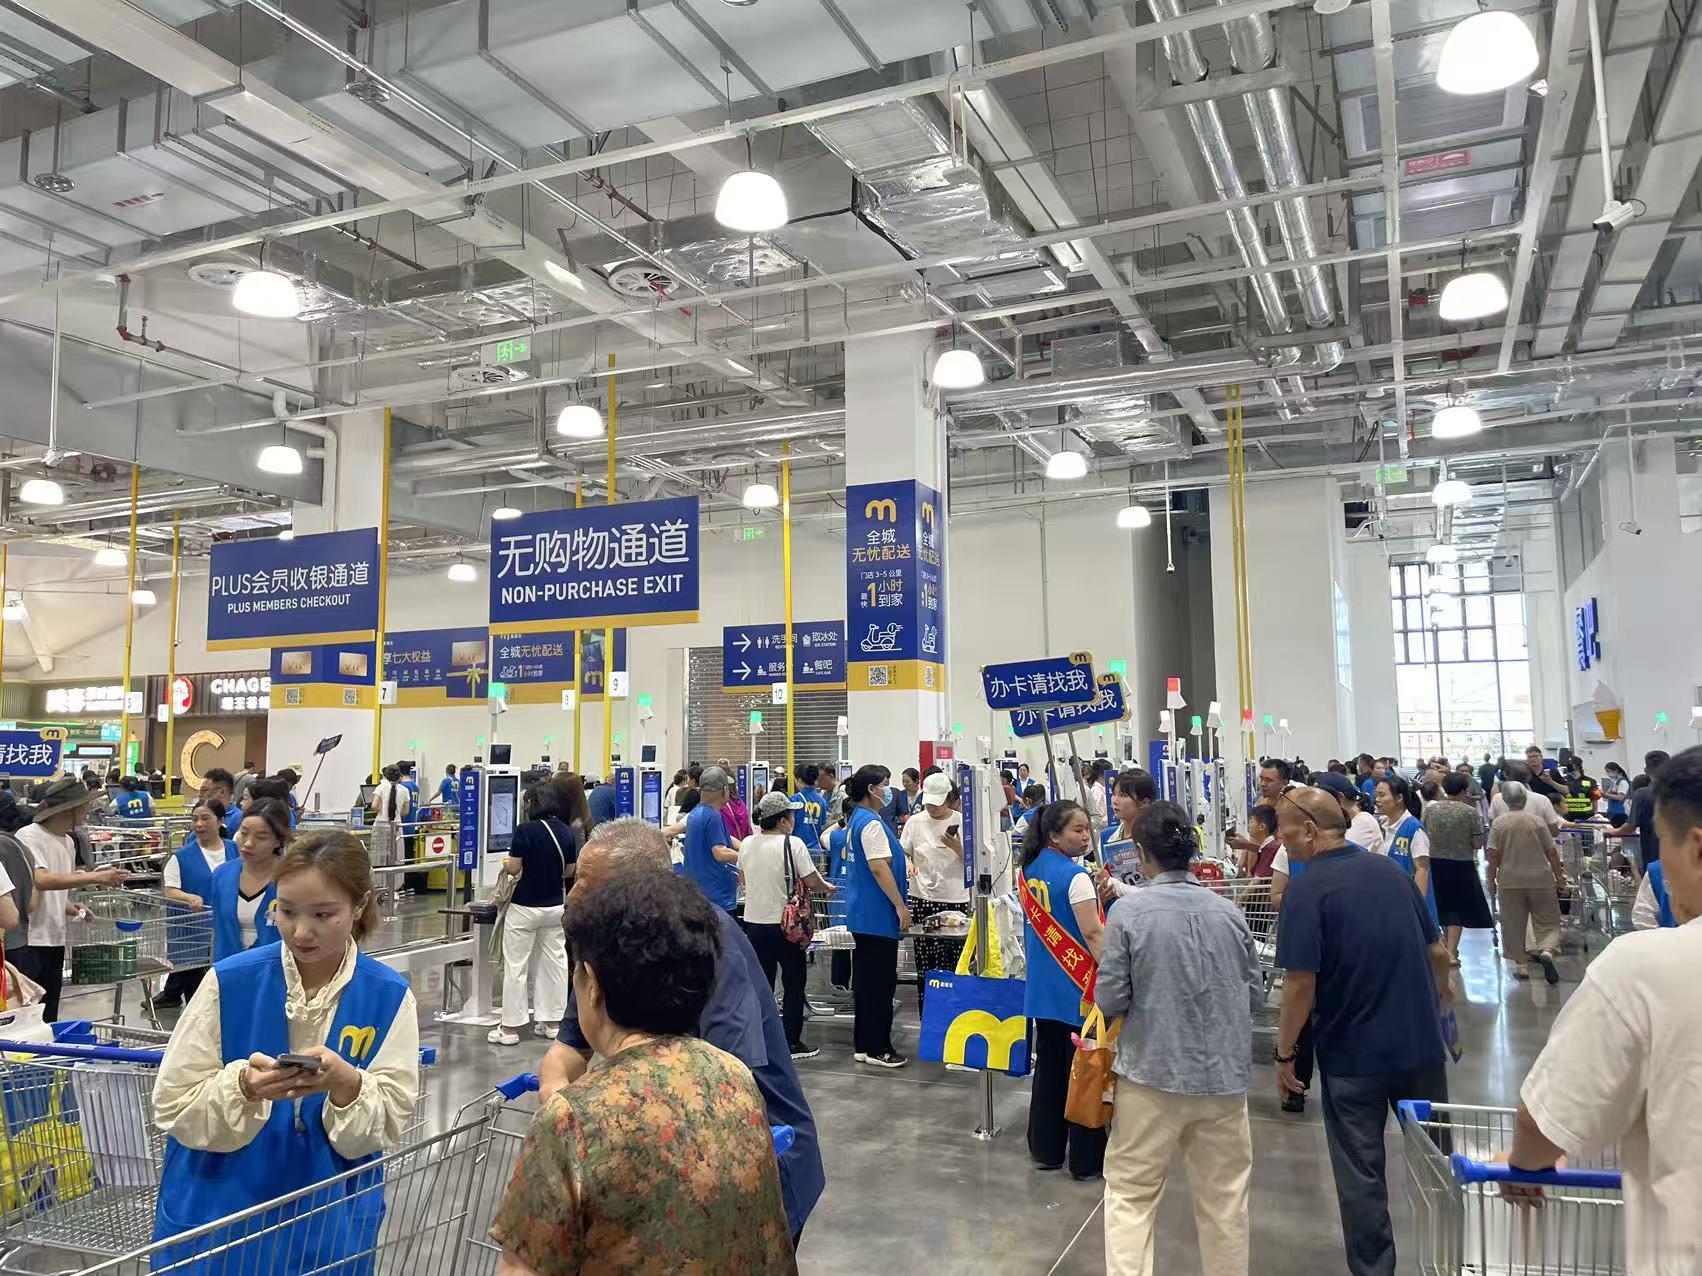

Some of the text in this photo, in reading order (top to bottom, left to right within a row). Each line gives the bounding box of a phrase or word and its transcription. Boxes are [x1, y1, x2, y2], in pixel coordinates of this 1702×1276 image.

[867, 528, 896, 545] 全城
[497, 518, 690, 579] 无购物通道
[852, 544, 911, 562] 无忧配送
[211, 561, 369, 597] PLUS会员收银通道
[878, 579, 903, 592] 小时
[501, 574, 684, 605] NON-PURCHASE EXIT
[867, 582, 876, 607] 1
[227, 593, 351, 614] PLUS MEMBERS CHECKOUT
[878, 593, 903, 607] 到家
[499, 643, 564, 659] 全城无忧配送
[768, 662, 788, 673] 服务
[990, 669, 1088, 698] 办卡请找我
[382, 687, 387, 700] 7
[775, 688, 783, 700] 10
